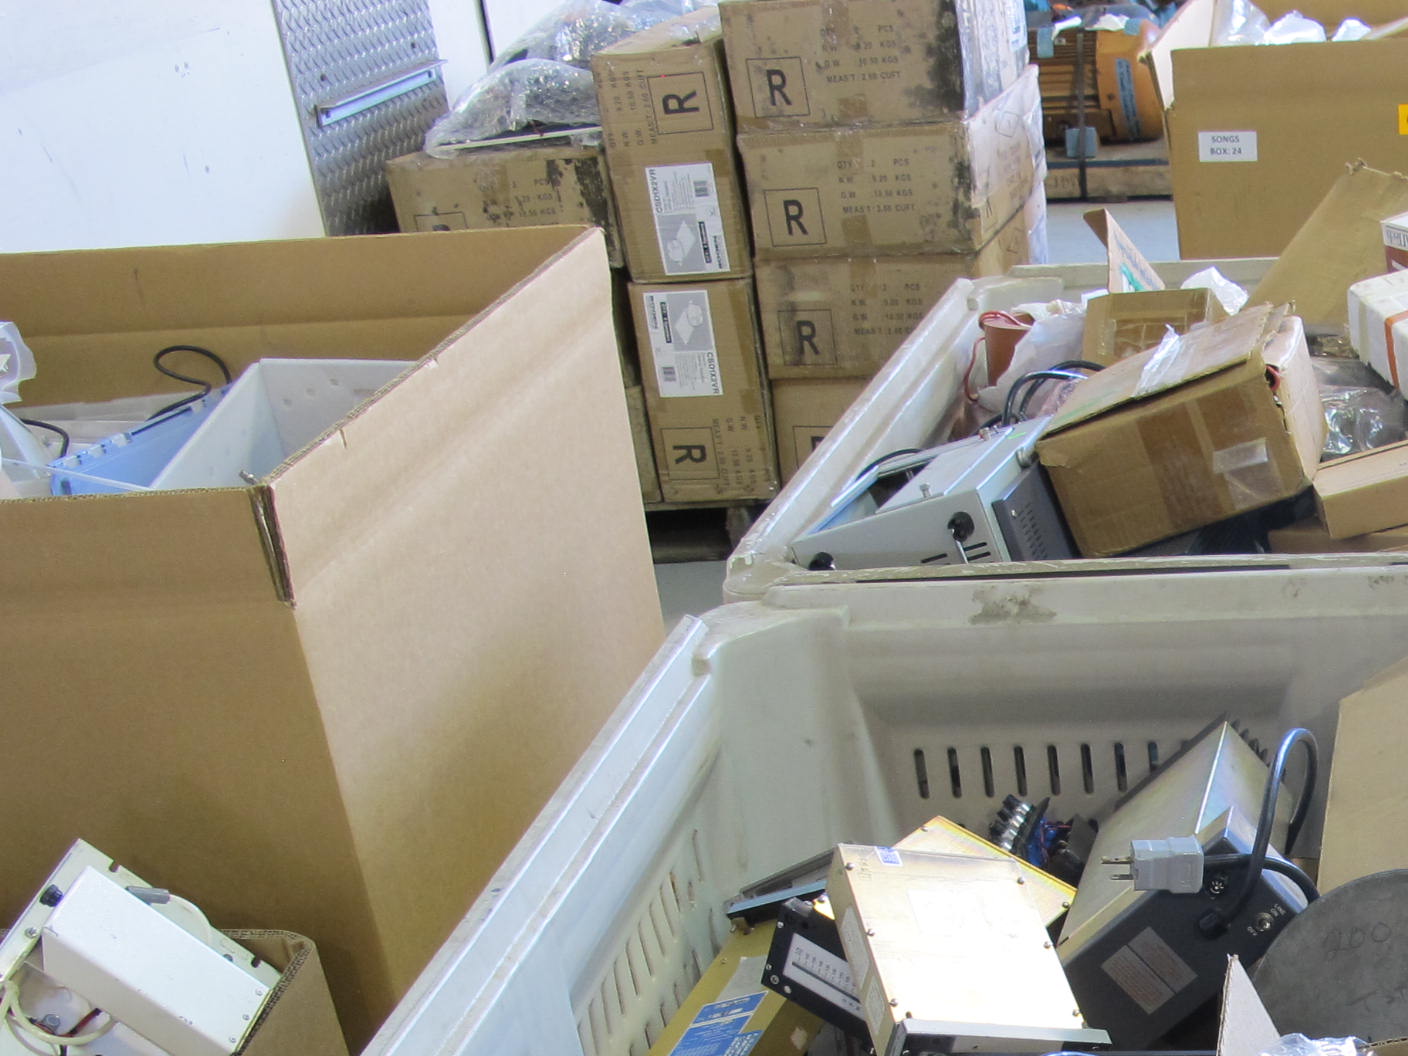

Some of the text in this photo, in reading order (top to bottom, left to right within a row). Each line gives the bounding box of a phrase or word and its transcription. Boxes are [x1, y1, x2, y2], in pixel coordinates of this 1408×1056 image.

[766, 69, 792, 106] R
[662, 90, 700, 115] R
[1211, 135, 1240, 143] SONGS
[1231, 146, 1242, 155] 24
[783, 200, 808, 236] R
[796, 320, 820, 355] R
[672, 445, 707, 464] R
